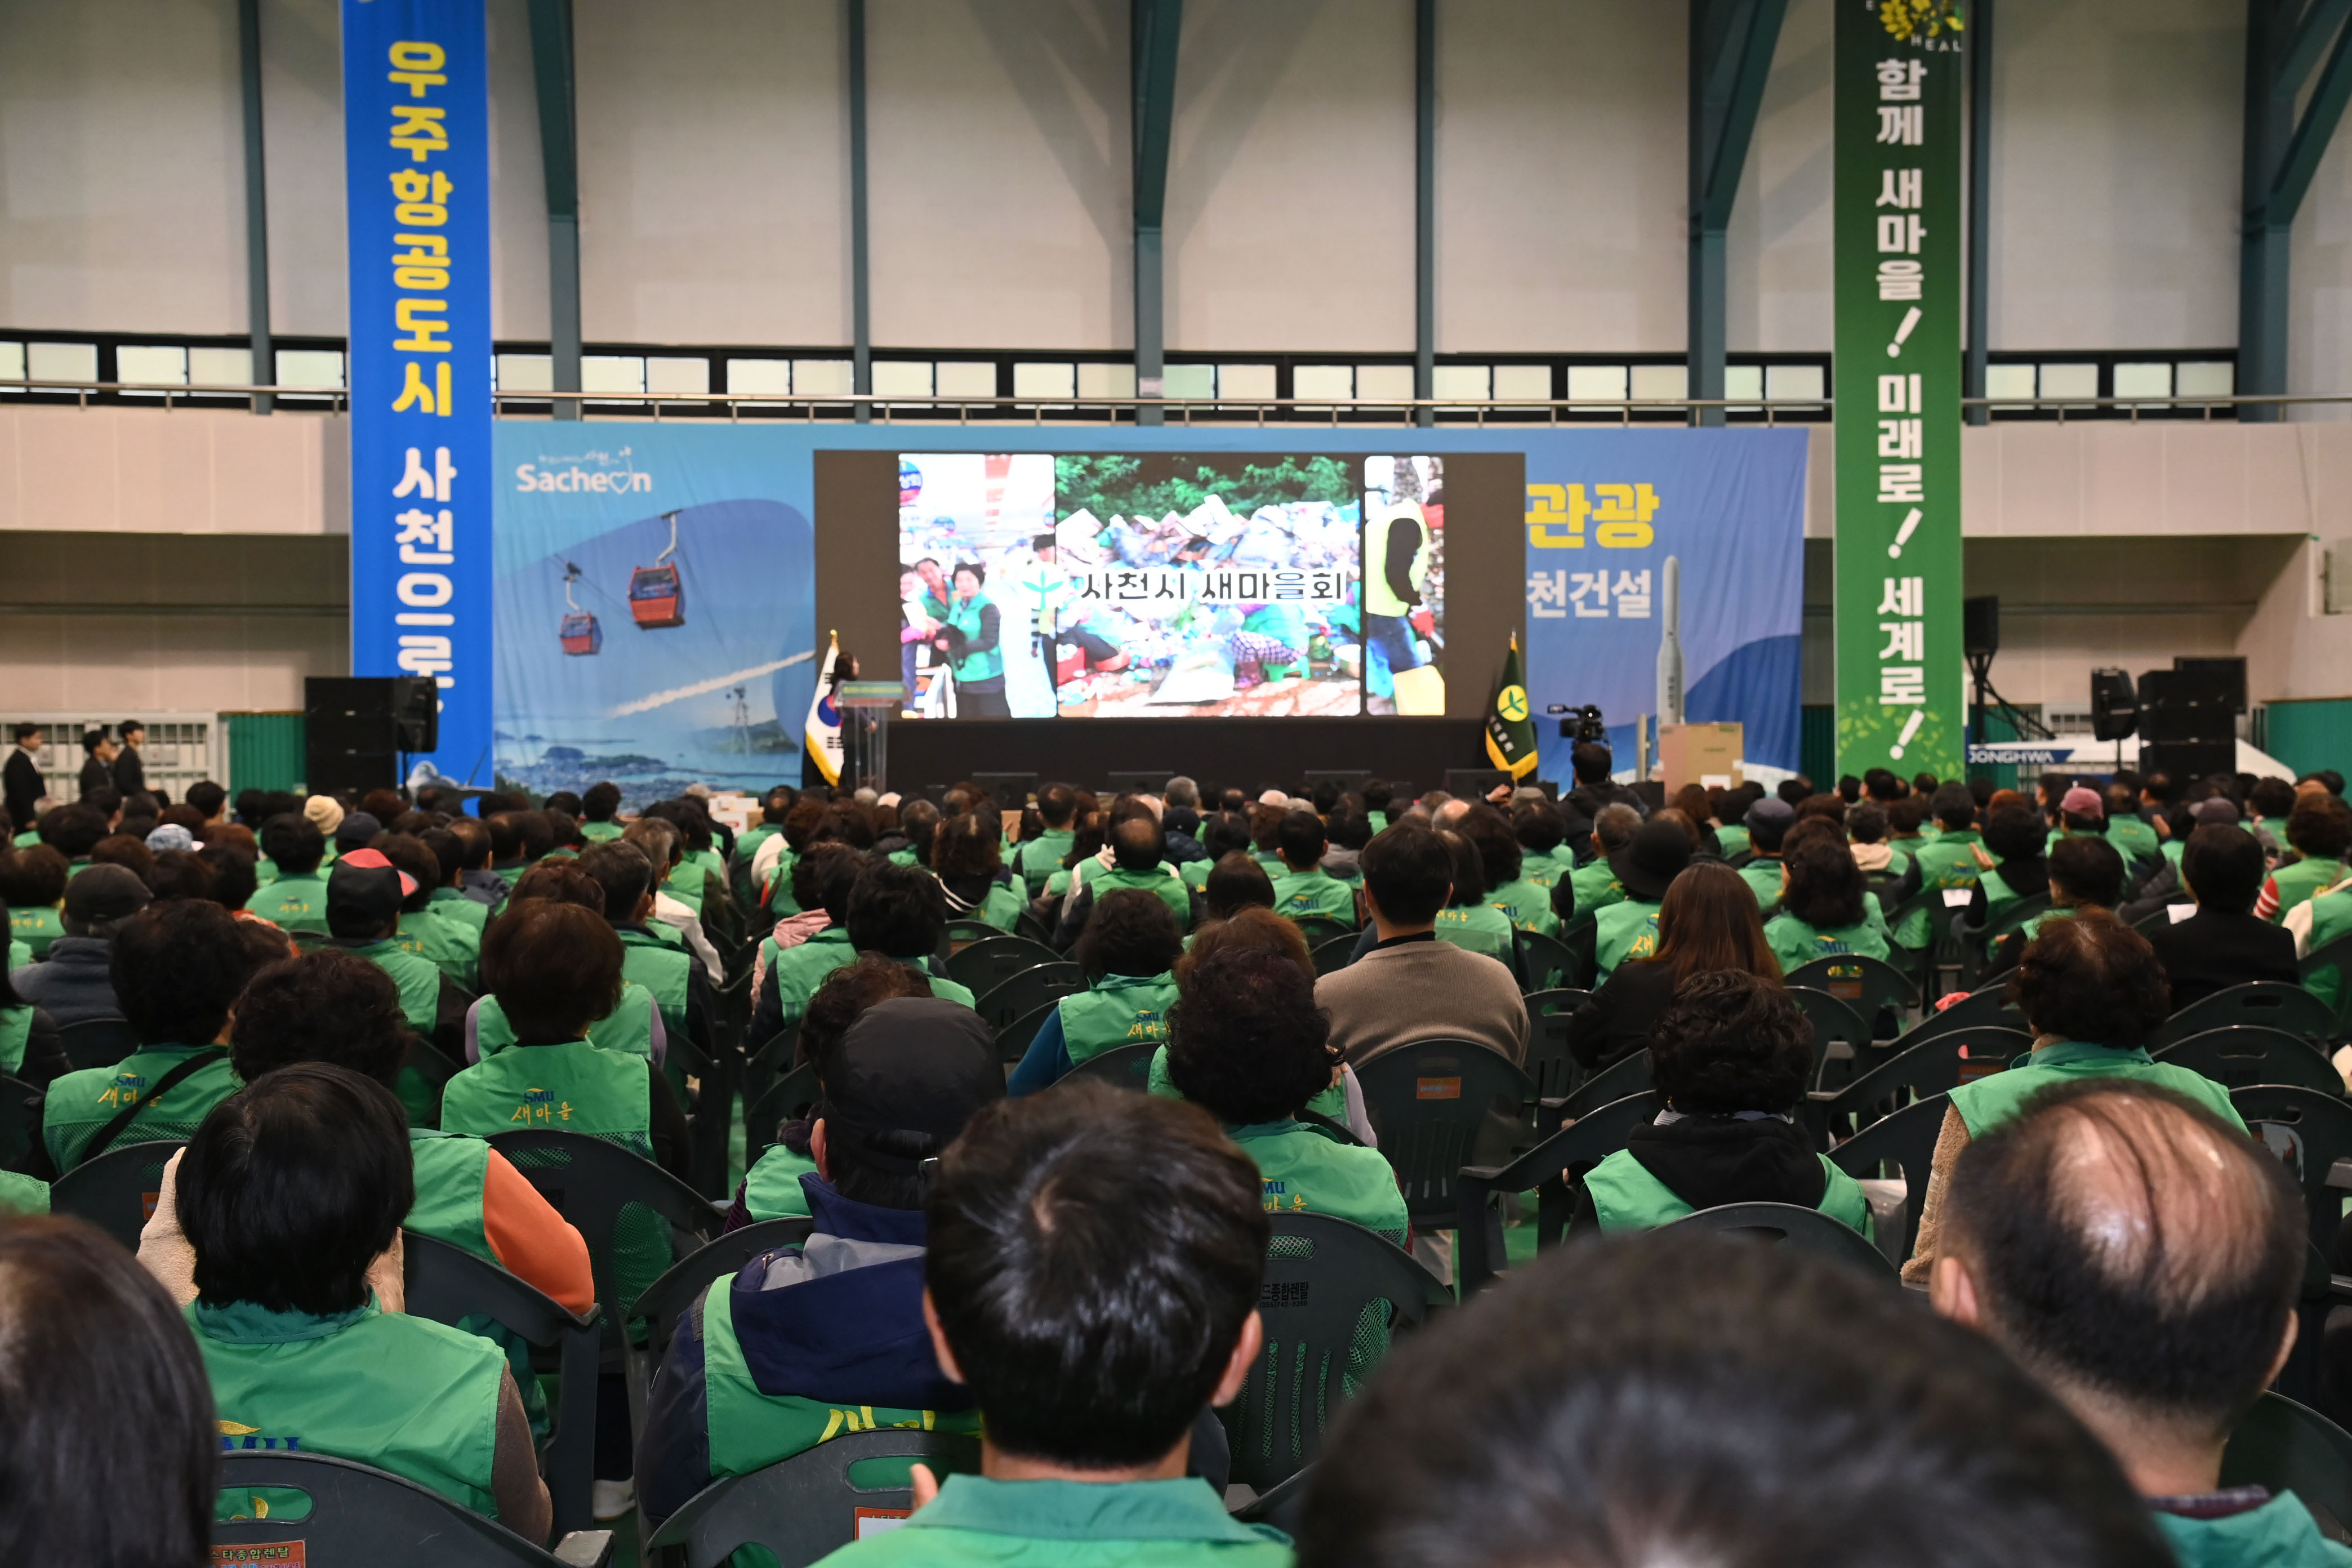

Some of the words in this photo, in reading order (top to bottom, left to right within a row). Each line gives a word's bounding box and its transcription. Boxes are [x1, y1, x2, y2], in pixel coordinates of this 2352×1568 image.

[1876, 59, 1927, 145] 함께
[387, 41, 453, 416] 우주항공도시
[1876, 168, 1927, 358] 새마을!
[1877, 374, 1925, 559] 미래로!
[1525, 483, 1660, 549] 관광
[392, 447, 457, 714] 사천으로
[1081, 573, 1184, 600] 사천시
[1201, 572, 1342, 600] 새마을회
[1527, 569, 1651, 618] 천건설
[1877, 577, 1926, 760] 세계로!
[115, 1076, 146, 1088] SMU
[510, 1101, 573, 1125] 새마을
[524, 1091, 555, 1103] SMU
